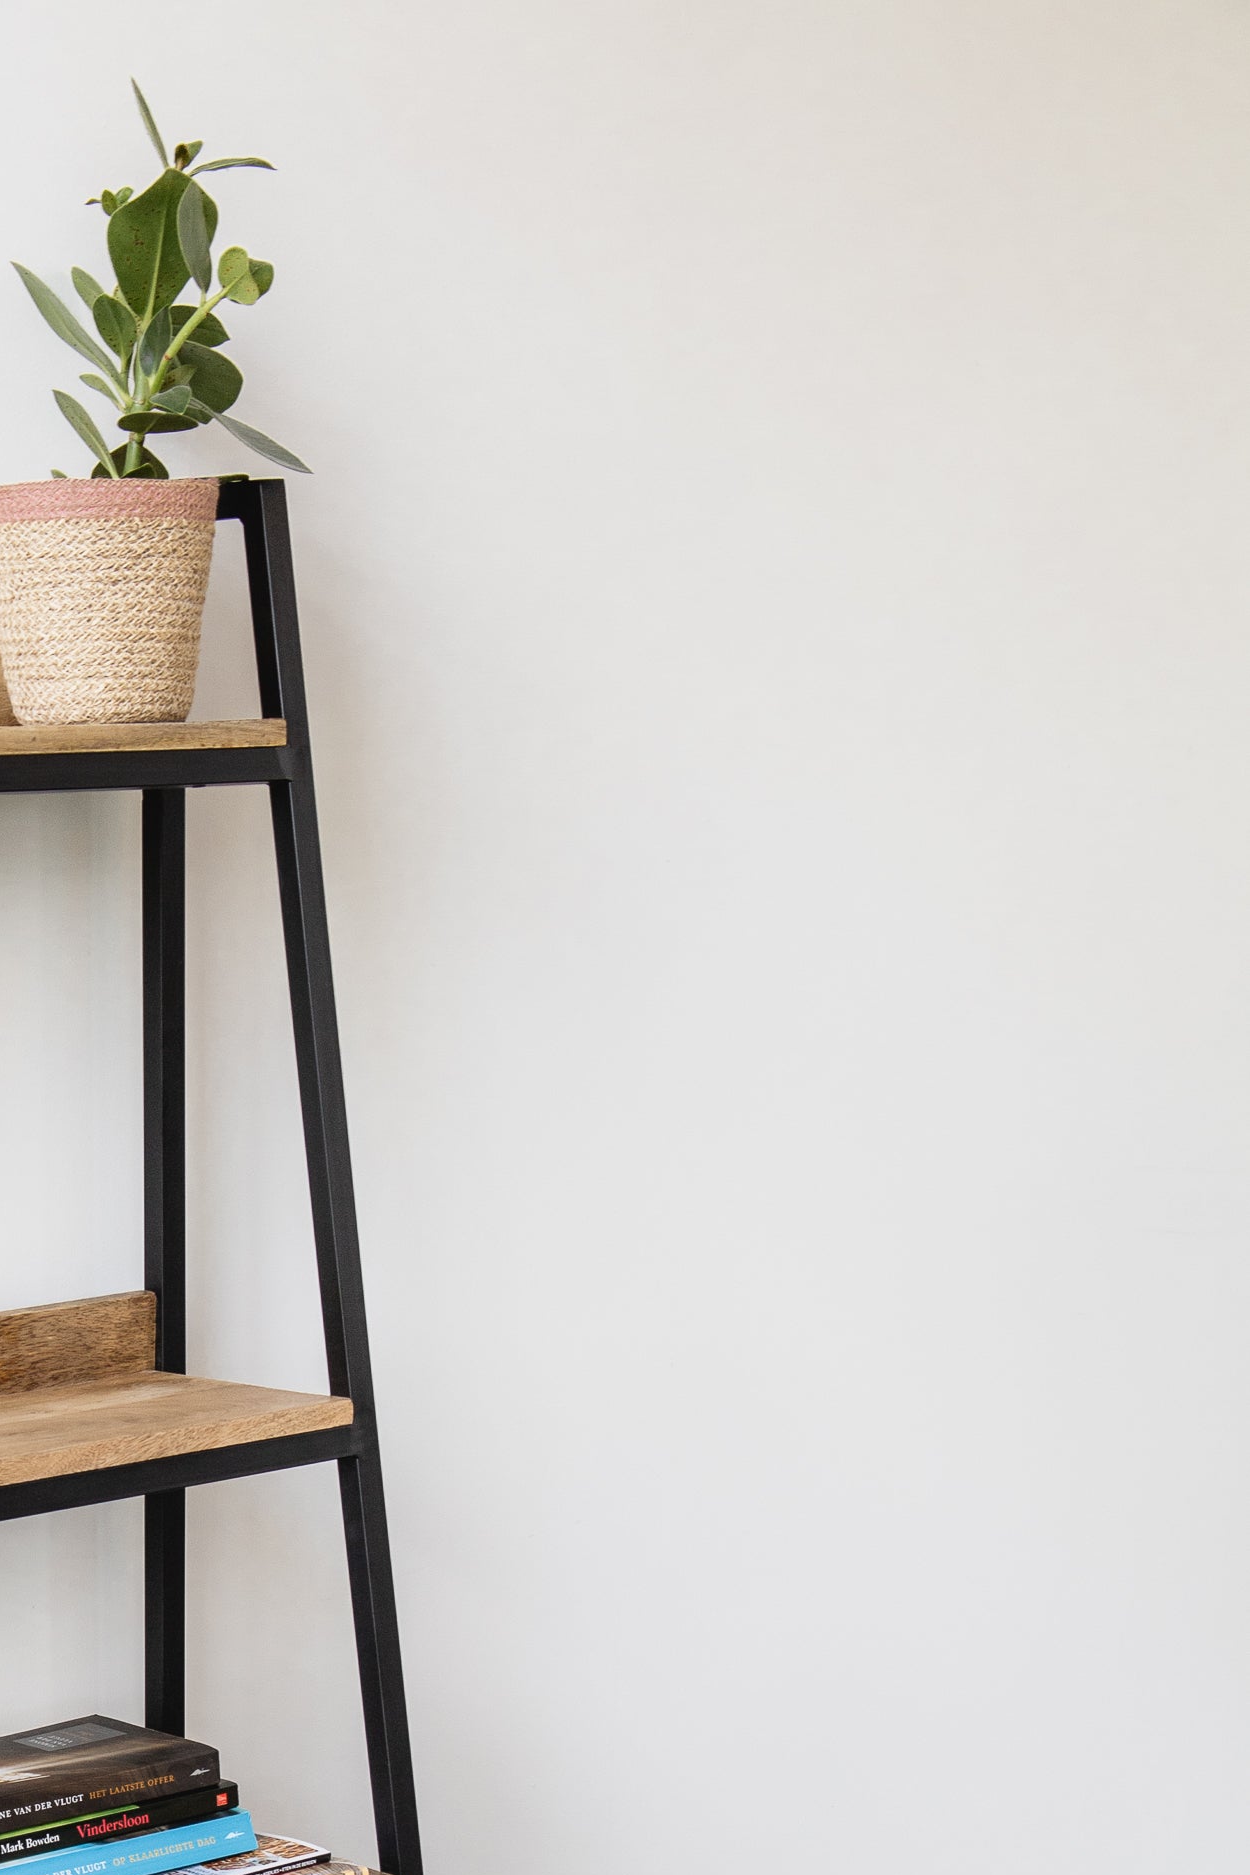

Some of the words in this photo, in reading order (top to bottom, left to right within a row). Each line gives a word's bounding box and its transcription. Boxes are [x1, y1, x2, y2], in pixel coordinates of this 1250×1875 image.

[14, 1804, 32, 1816] VAN
[34, 1800, 52, 1813] DER
[54, 1793, 84, 1808] VLUGT
[89, 1788, 106, 1800] HET
[109, 1780, 145, 1795] LAATSTE
[147, 1774, 175, 1787] OFFER
[0, 1840, 25, 1855] Mark
[26, 1833, 60, 1848] Bowden
[76, 1812, 149, 1839] Vindersloon
[112, 1855, 125, 1867] OP
[129, 1842, 194, 1863] KLAARLICHTE
[197, 1836, 217, 1848] DAG
